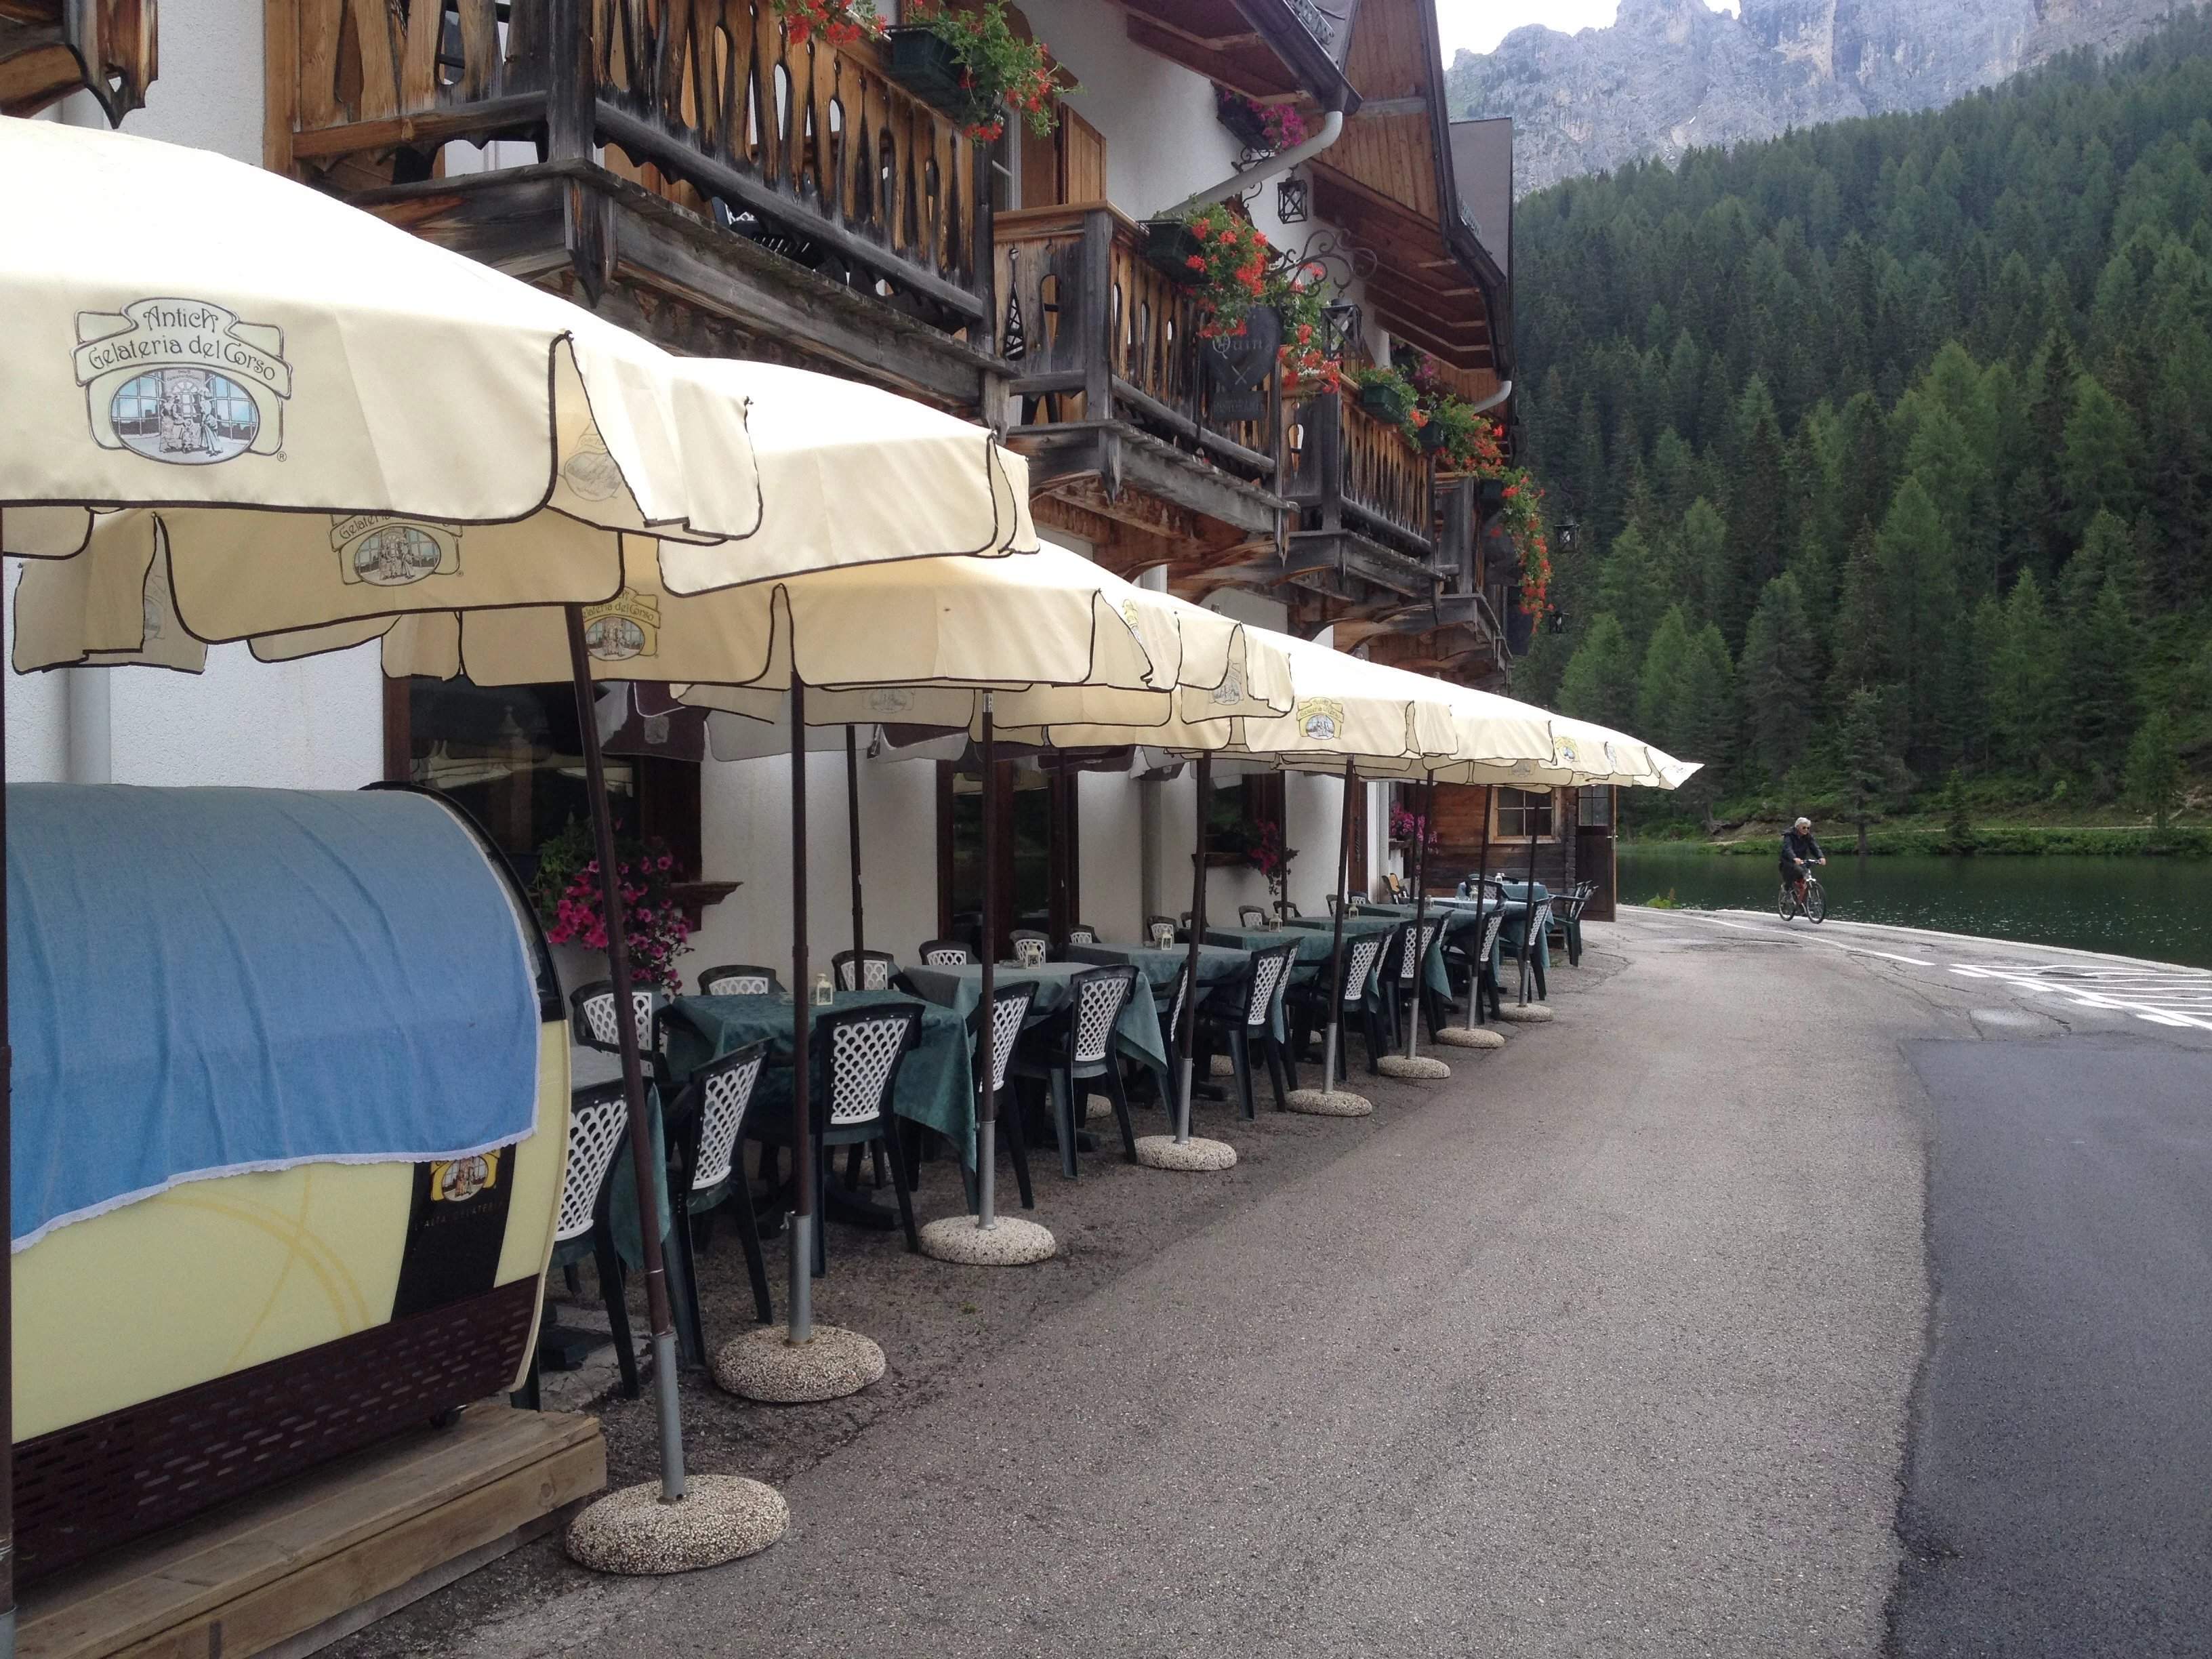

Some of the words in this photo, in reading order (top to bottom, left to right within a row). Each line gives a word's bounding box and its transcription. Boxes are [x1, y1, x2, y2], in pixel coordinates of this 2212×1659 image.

[89, 335, 182, 370] Gelateria
[189, 335, 220, 359] del
[224, 342, 276, 381] Corso
[630, 605, 654, 621] Corso
